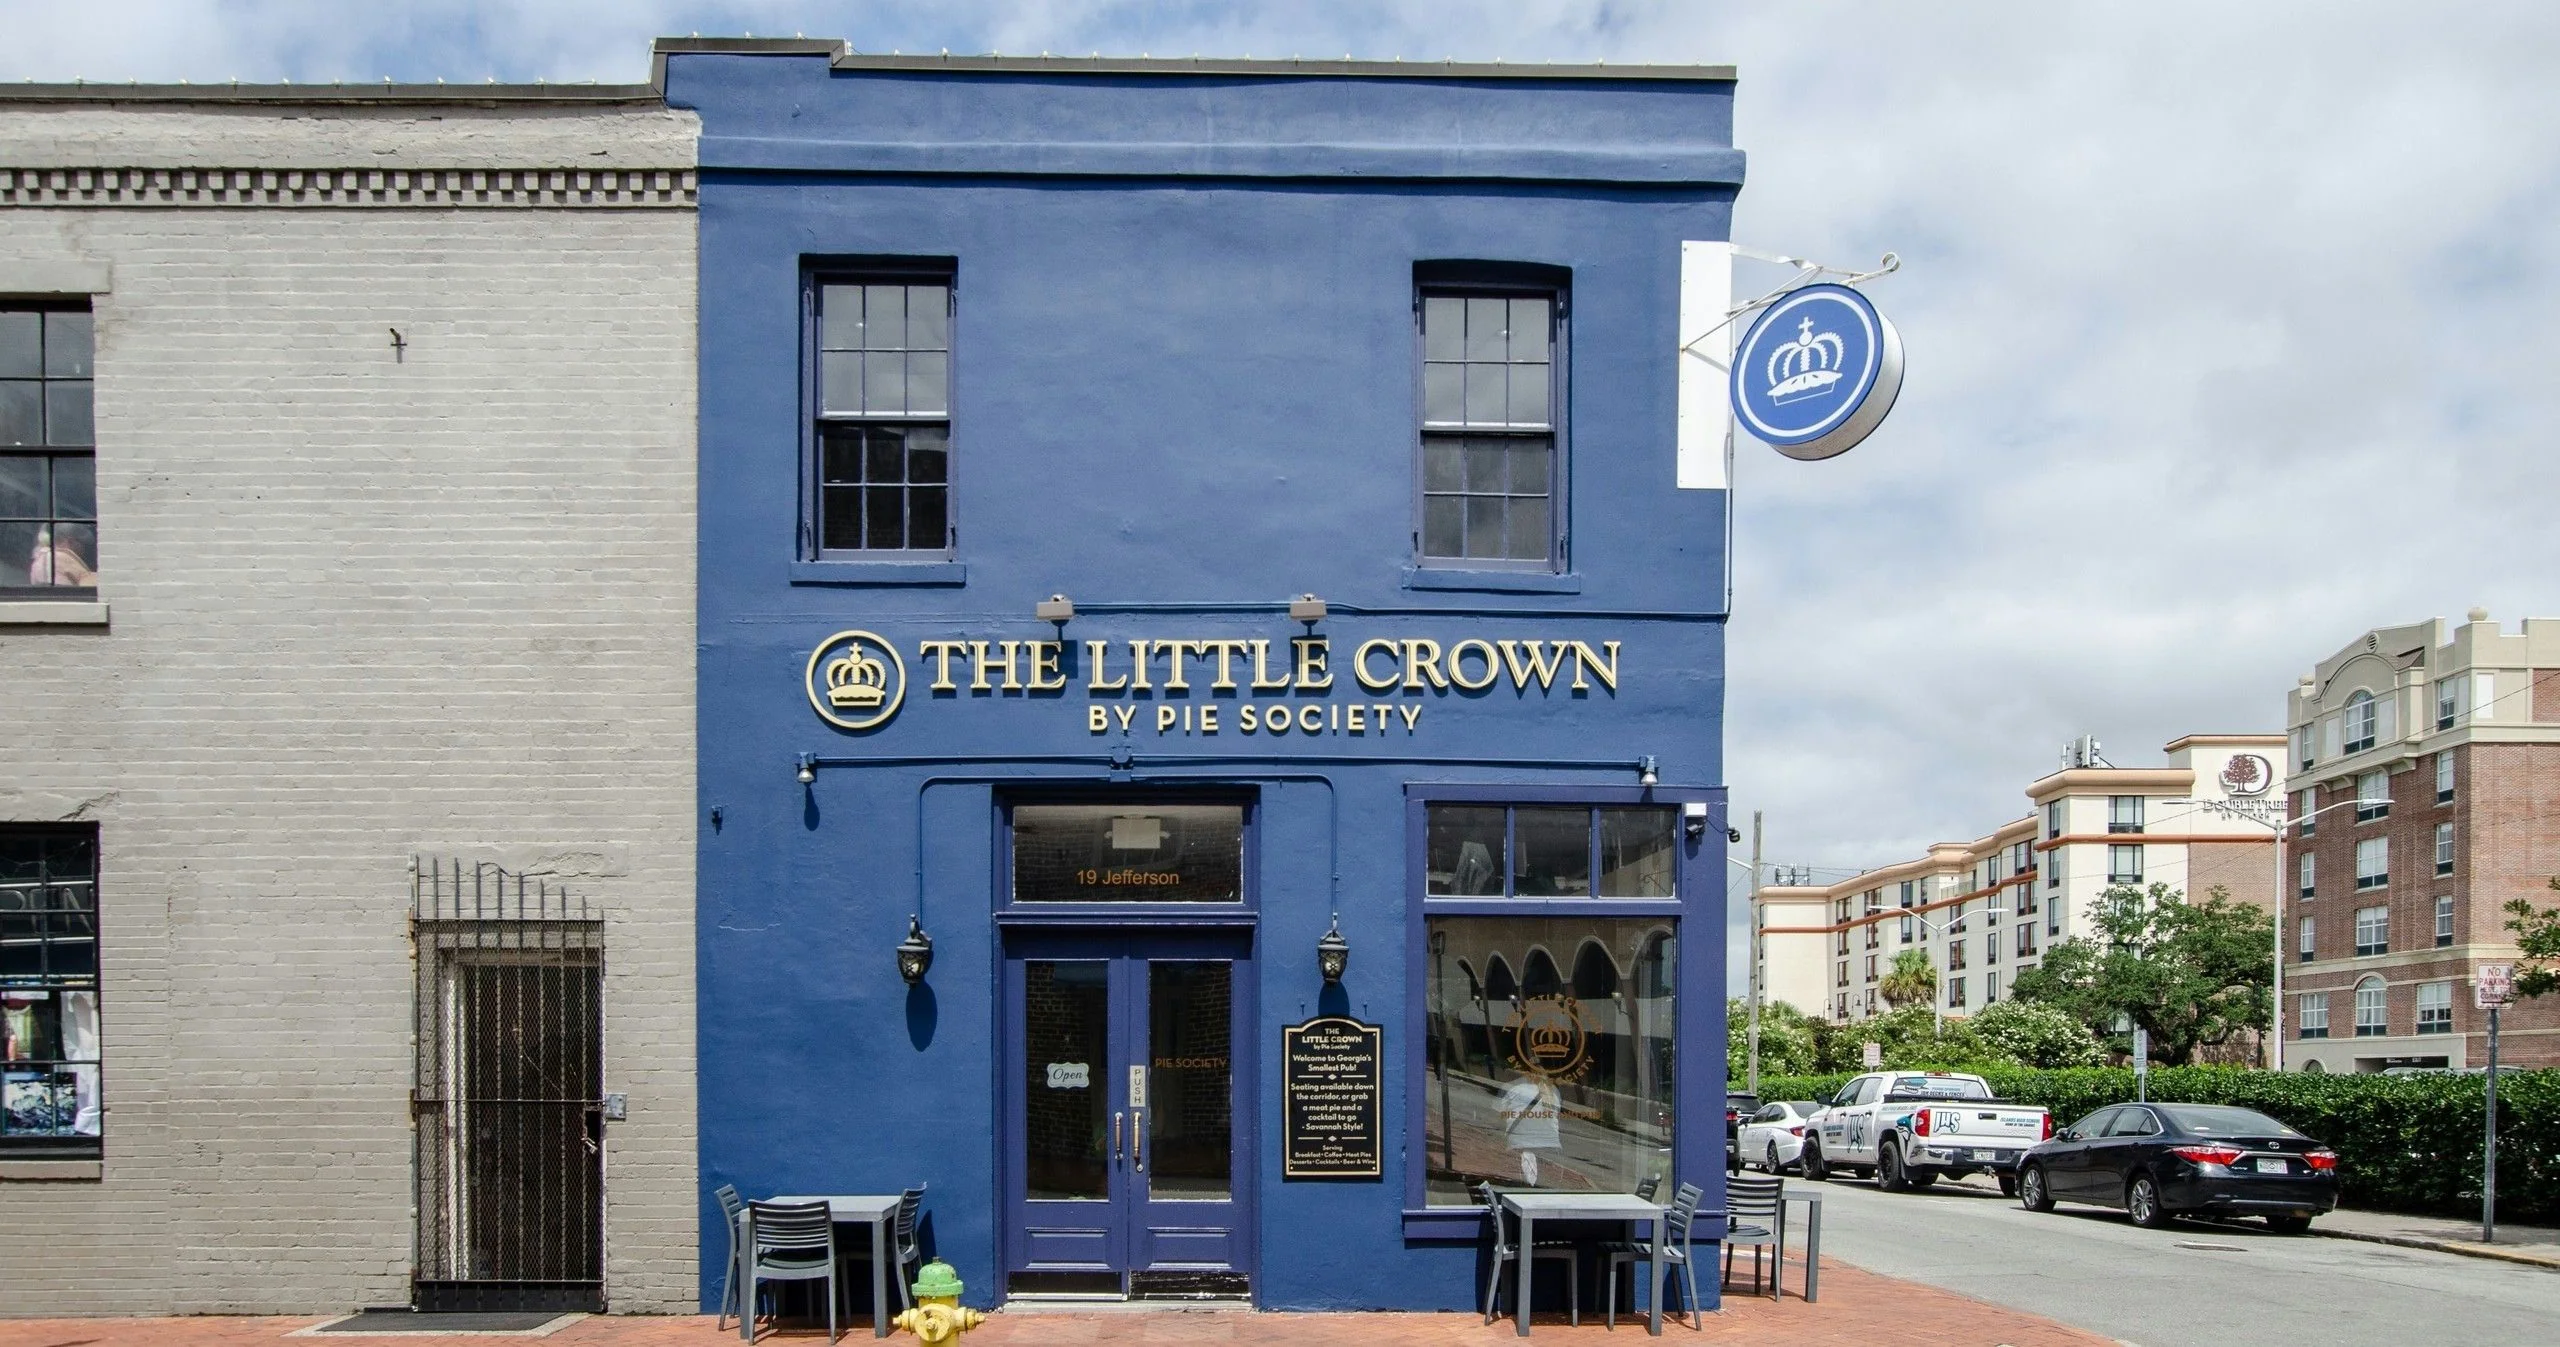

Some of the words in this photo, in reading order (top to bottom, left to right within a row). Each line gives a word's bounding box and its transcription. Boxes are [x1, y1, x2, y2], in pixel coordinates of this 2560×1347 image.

[919, 640, 1067, 690] THE
[1086, 639, 1334, 690] LITTLE
[1353, 638, 1622, 690] CROWN
[1088, 704, 1136, 732] BY
[1157, 704, 1219, 732] PIE
[1240, 704, 1422, 732] SOCIETY
[1076, 869, 1097, 885] 19
[1102, 869, 1180, 885] Jefferson
[2487, 967, 2501, 977] NO
[1155, 1058, 1173, 1068] PIE
[1175, 1058, 1227, 1068] SOCIETY
[1337, 1054, 1372, 1063] Georgia's
[1308, 1064, 1339, 1072] Smallest
[1053, 1068, 1082, 1082] Open
[1134, 1069, 1142, 1103] PUSH
[1291, 1083, 1319, 1092] Seating
[1320, 1083, 1353, 1091] available
[1354, 1083, 1374, 1091] down
[1310, 1093, 1340, 1101] corridor,
[1351, 1093, 1368, 1101] grab
[1329, 1104, 1340, 1112] pie
[1343, 1123, 1363, 1132] Style!
